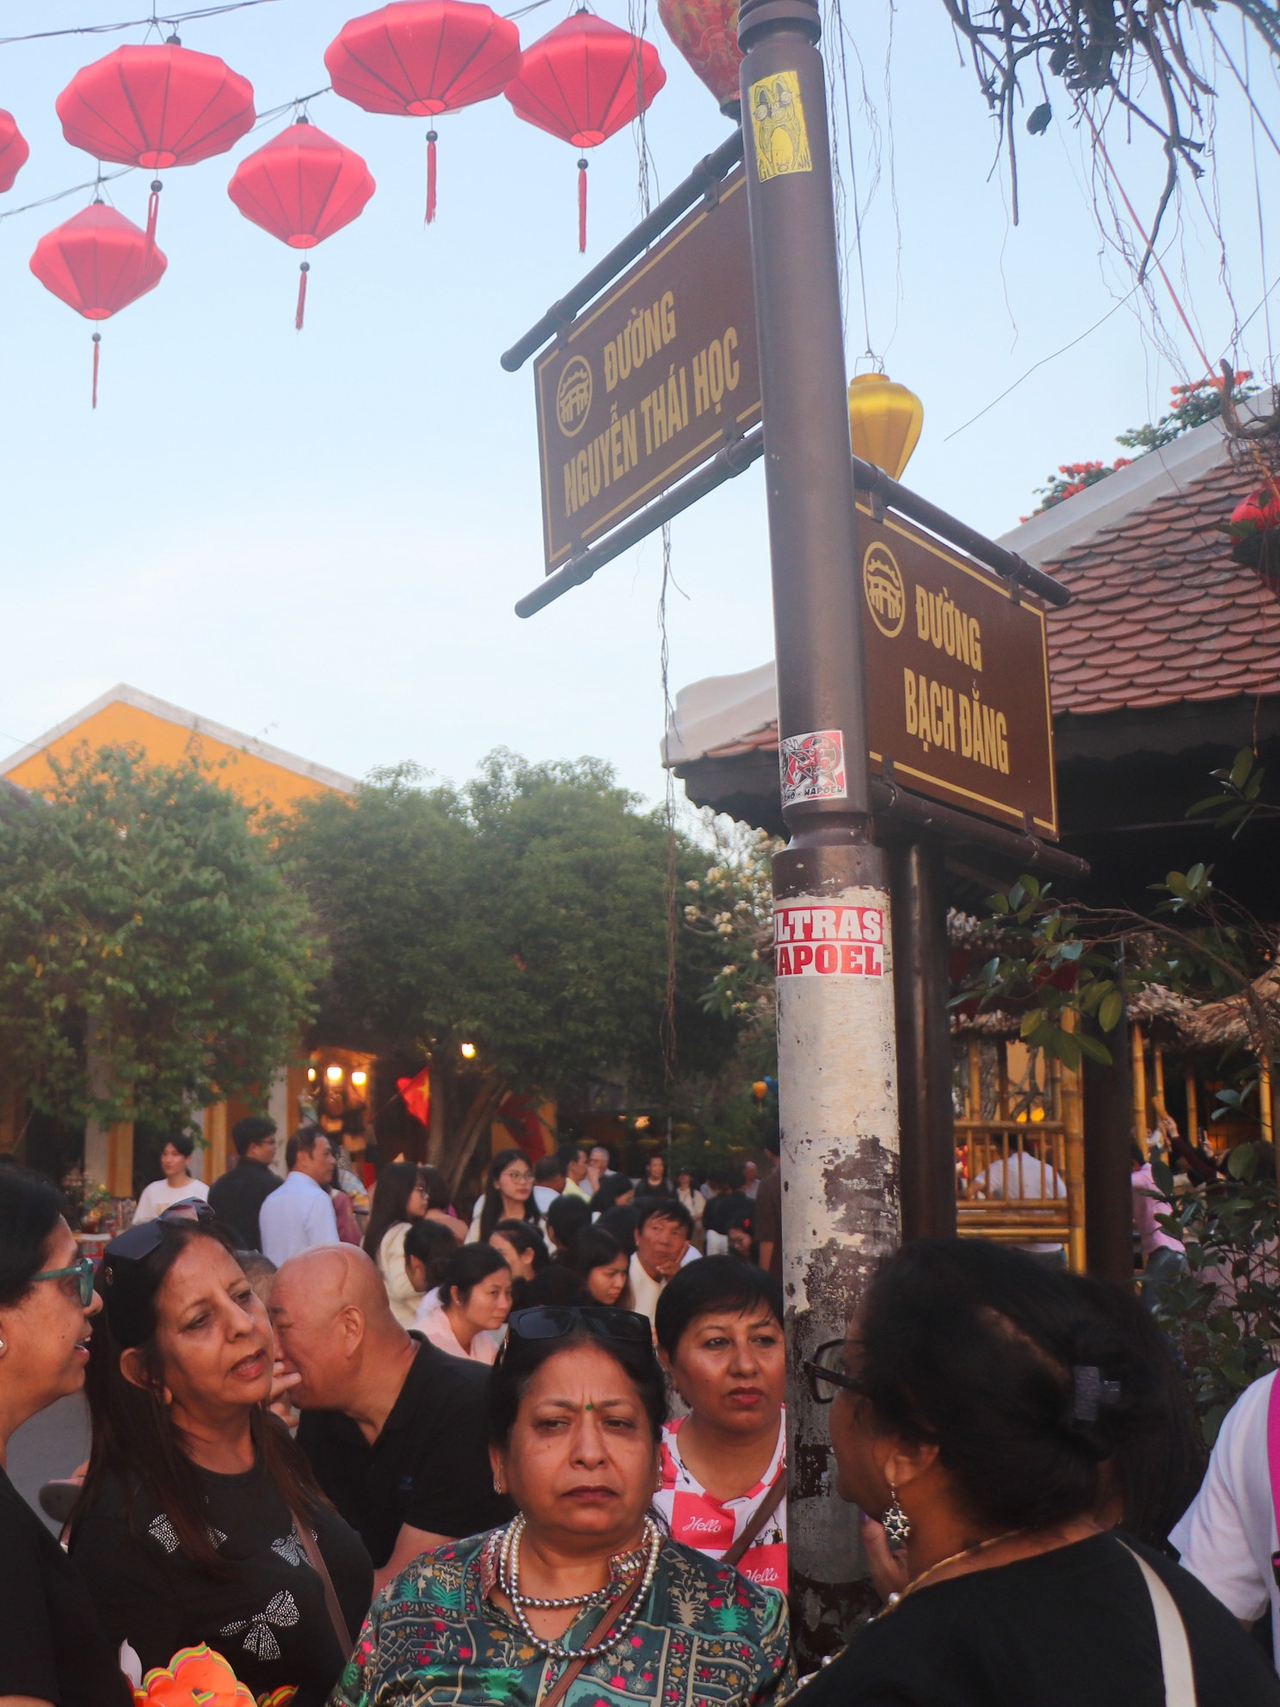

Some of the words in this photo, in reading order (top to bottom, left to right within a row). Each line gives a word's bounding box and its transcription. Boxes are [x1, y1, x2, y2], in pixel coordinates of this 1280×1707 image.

[603, 290, 677, 394] ĐƯỜNG
[563, 401, 639, 518] NGUYỄN
[640, 363, 689, 457] THÁI
[692, 326, 740, 415] HỌC
[915, 585, 983, 672] ĐƯỜNG
[903, 667, 956, 753] BẠCH
[774, 909, 882, 942] LTRAS
[774, 944, 882, 977] APOEL
[682, 1515, 723, 1533] Hello
[745, 1567, 779, 1583] Hello
